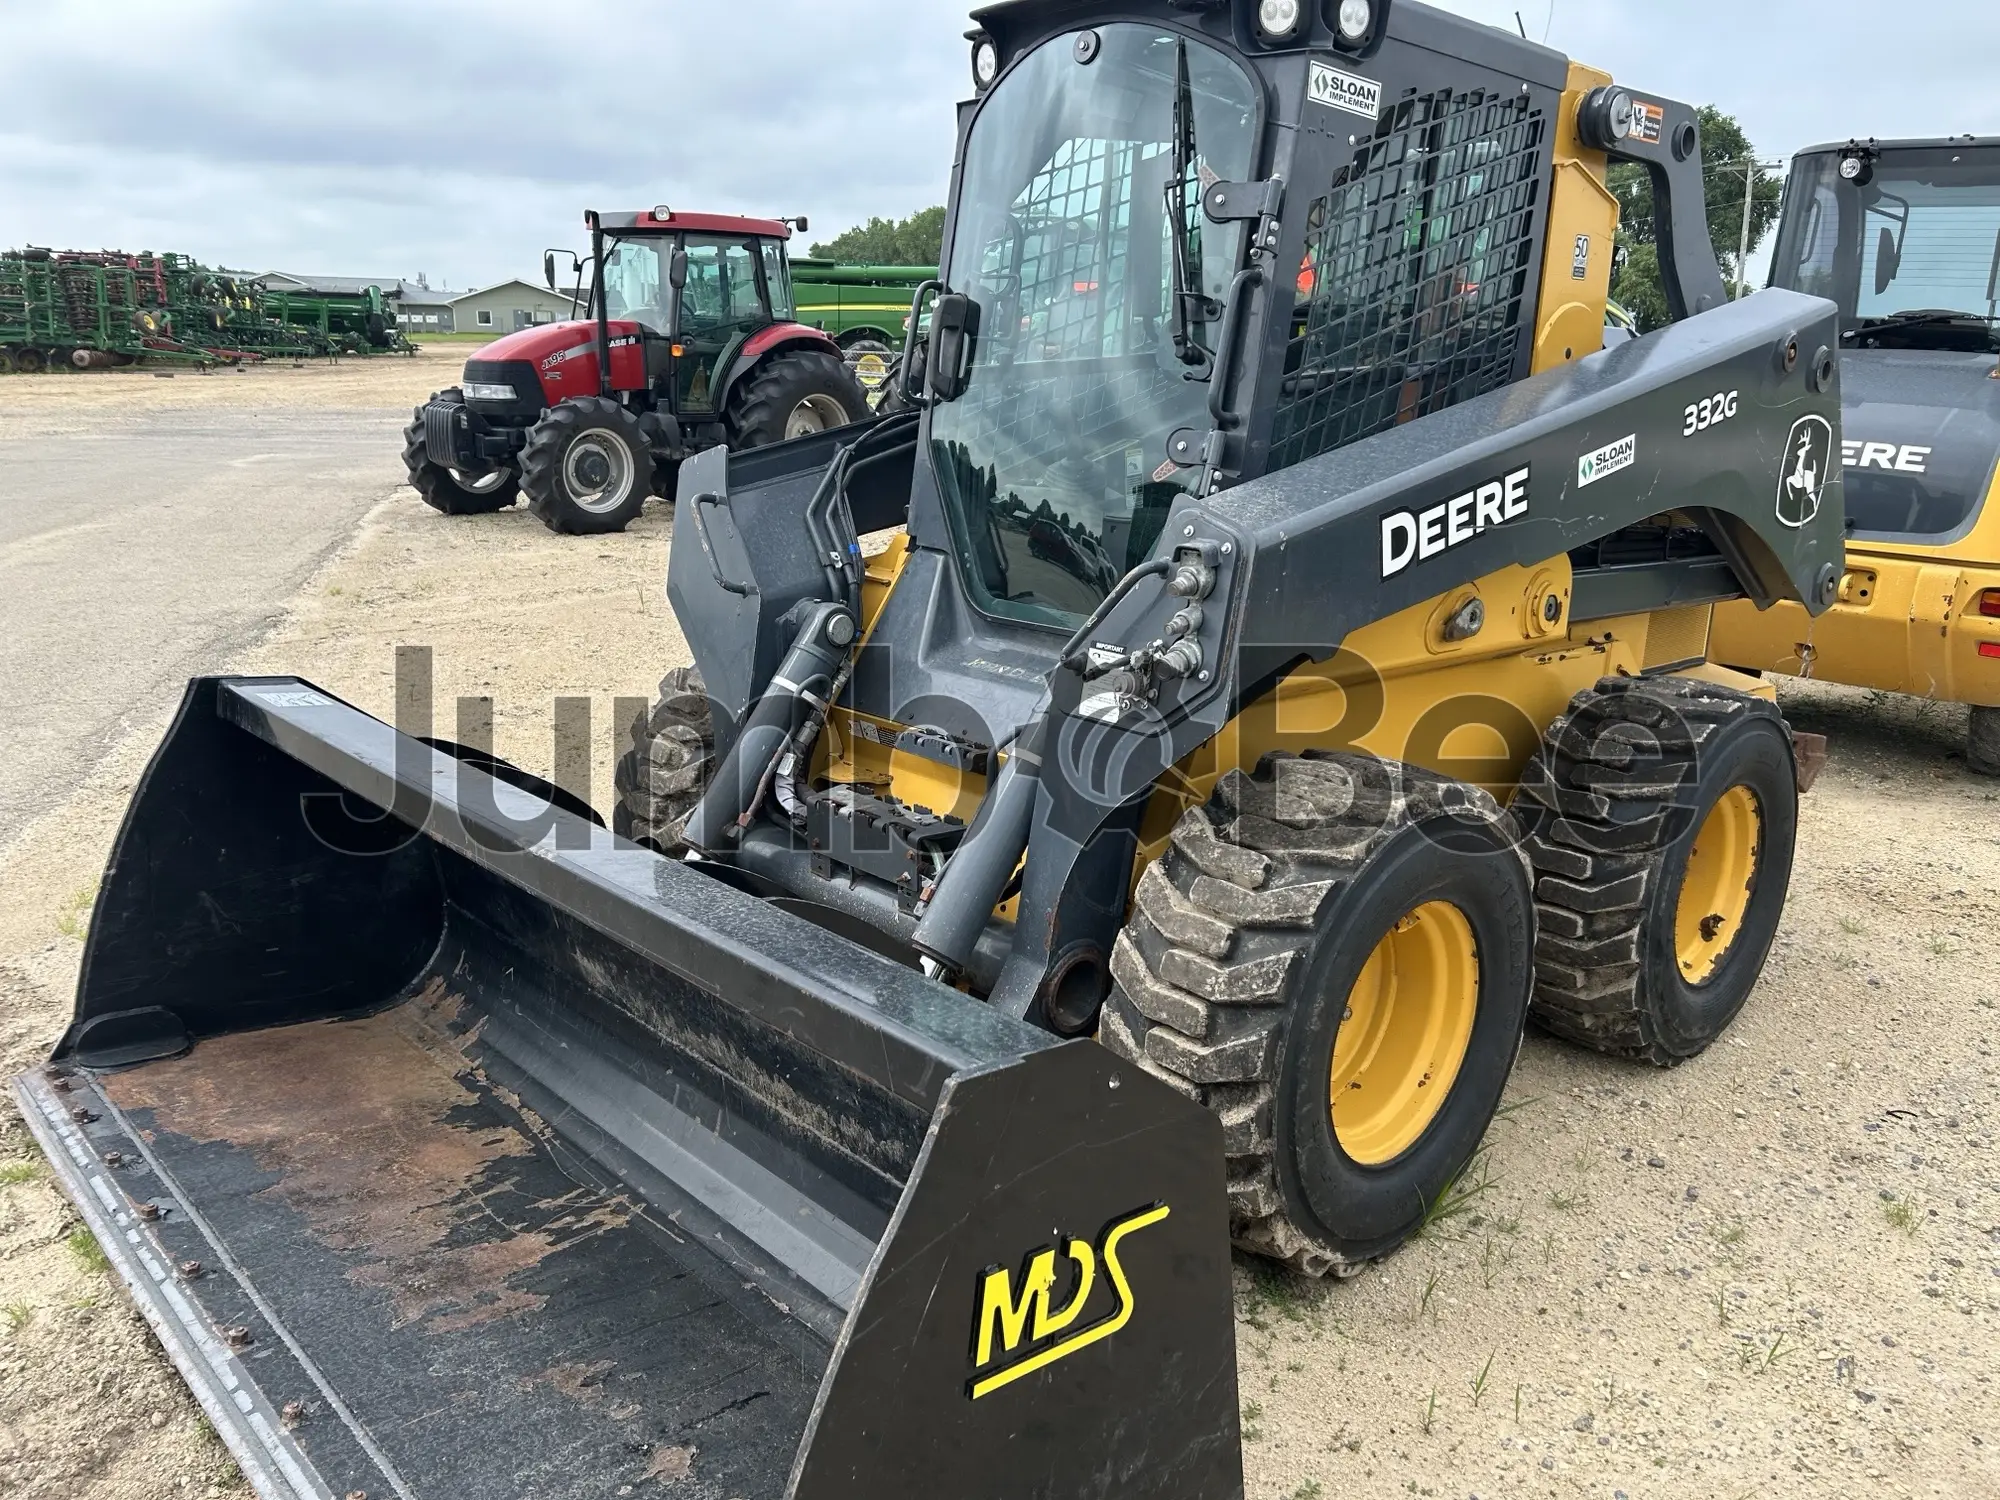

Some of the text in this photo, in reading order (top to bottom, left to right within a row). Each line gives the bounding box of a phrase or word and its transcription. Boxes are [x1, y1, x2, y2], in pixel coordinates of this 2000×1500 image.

[1329, 91, 1375, 111] IMPLEMENT
[1330, 76, 1376, 102] SLOAN
[542, 350, 566, 370] JX95
[1683, 390, 1738, 437] 332G
[1594, 452, 1632, 476] IMPLEMENT
[1595, 439, 1633, 466] SLOAN
[1381, 467, 1529, 578] DEERE
[1095, 642, 1125, 653] IMPORTANT
[972, 1205, 1171, 1400] MDS
